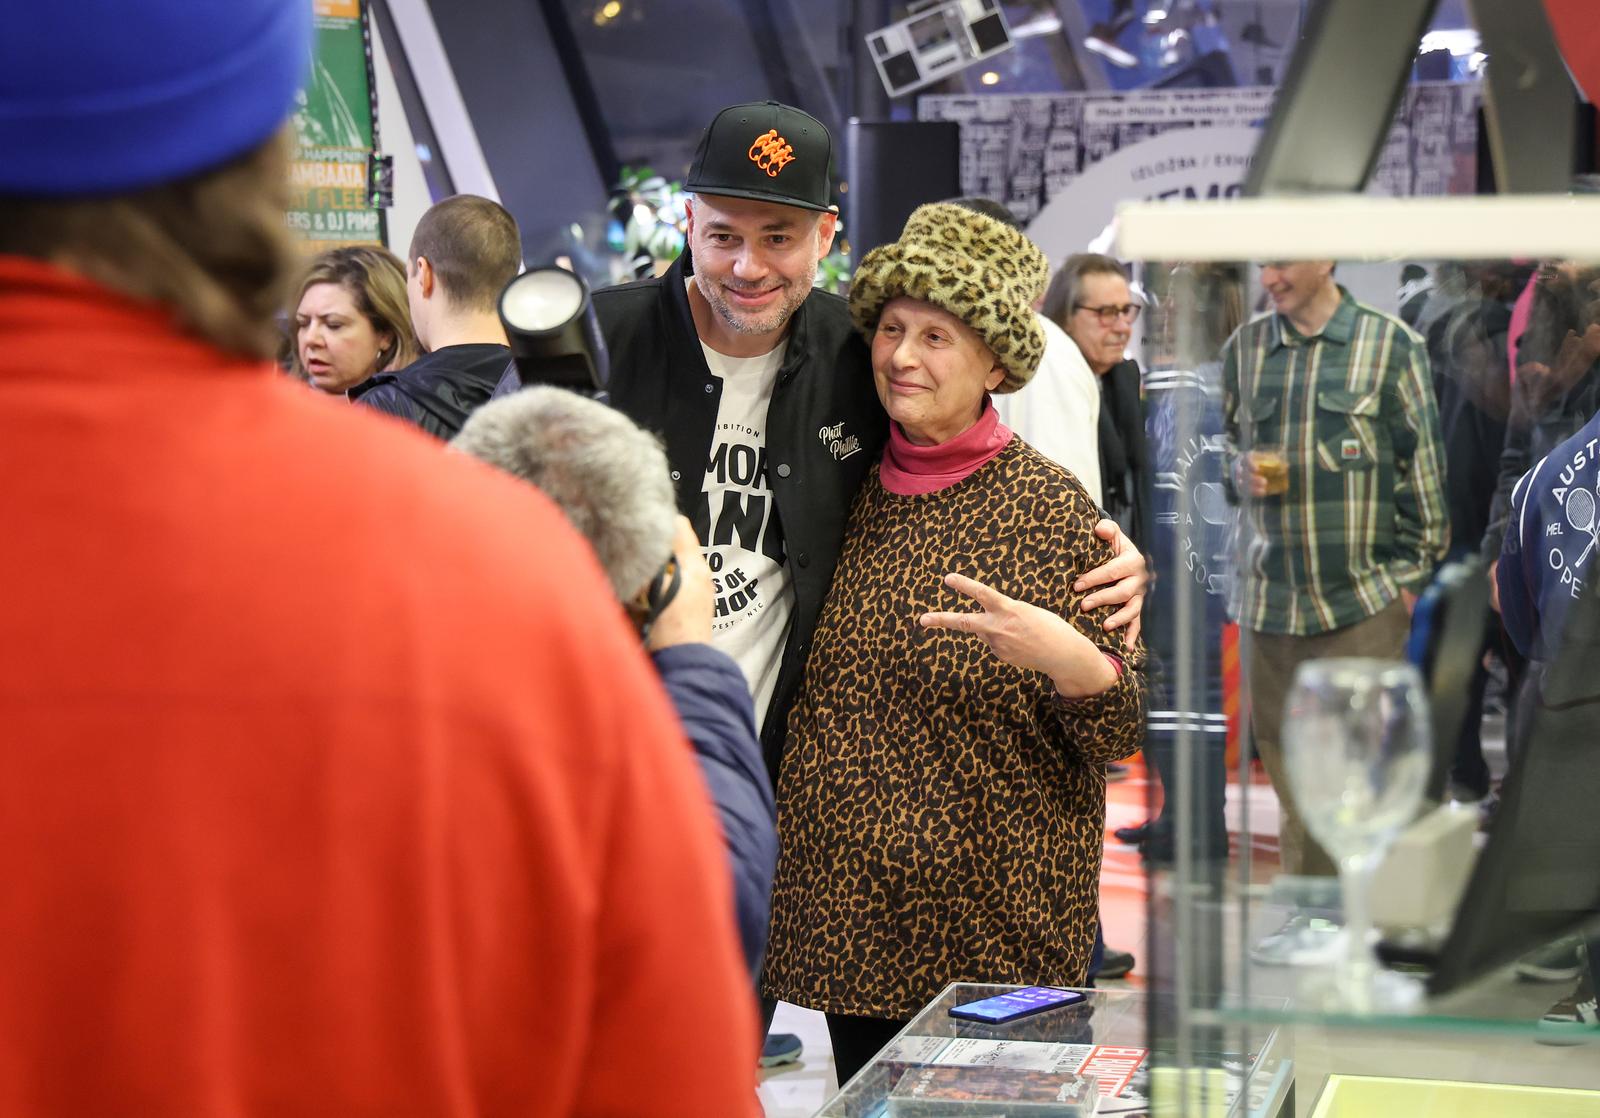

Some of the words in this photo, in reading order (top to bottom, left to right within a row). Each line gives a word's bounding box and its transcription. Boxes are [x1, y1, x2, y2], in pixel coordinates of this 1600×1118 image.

[313, 212, 325, 231] &
[326, 211, 345, 231] DJ
[818, 421, 846, 446] Phat
[1545, 522, 1564, 537] MEL
[724, 566, 748, 590] OF
[1549, 547, 1582, 600] OPE
[747, 602, 764, 618] NYC
